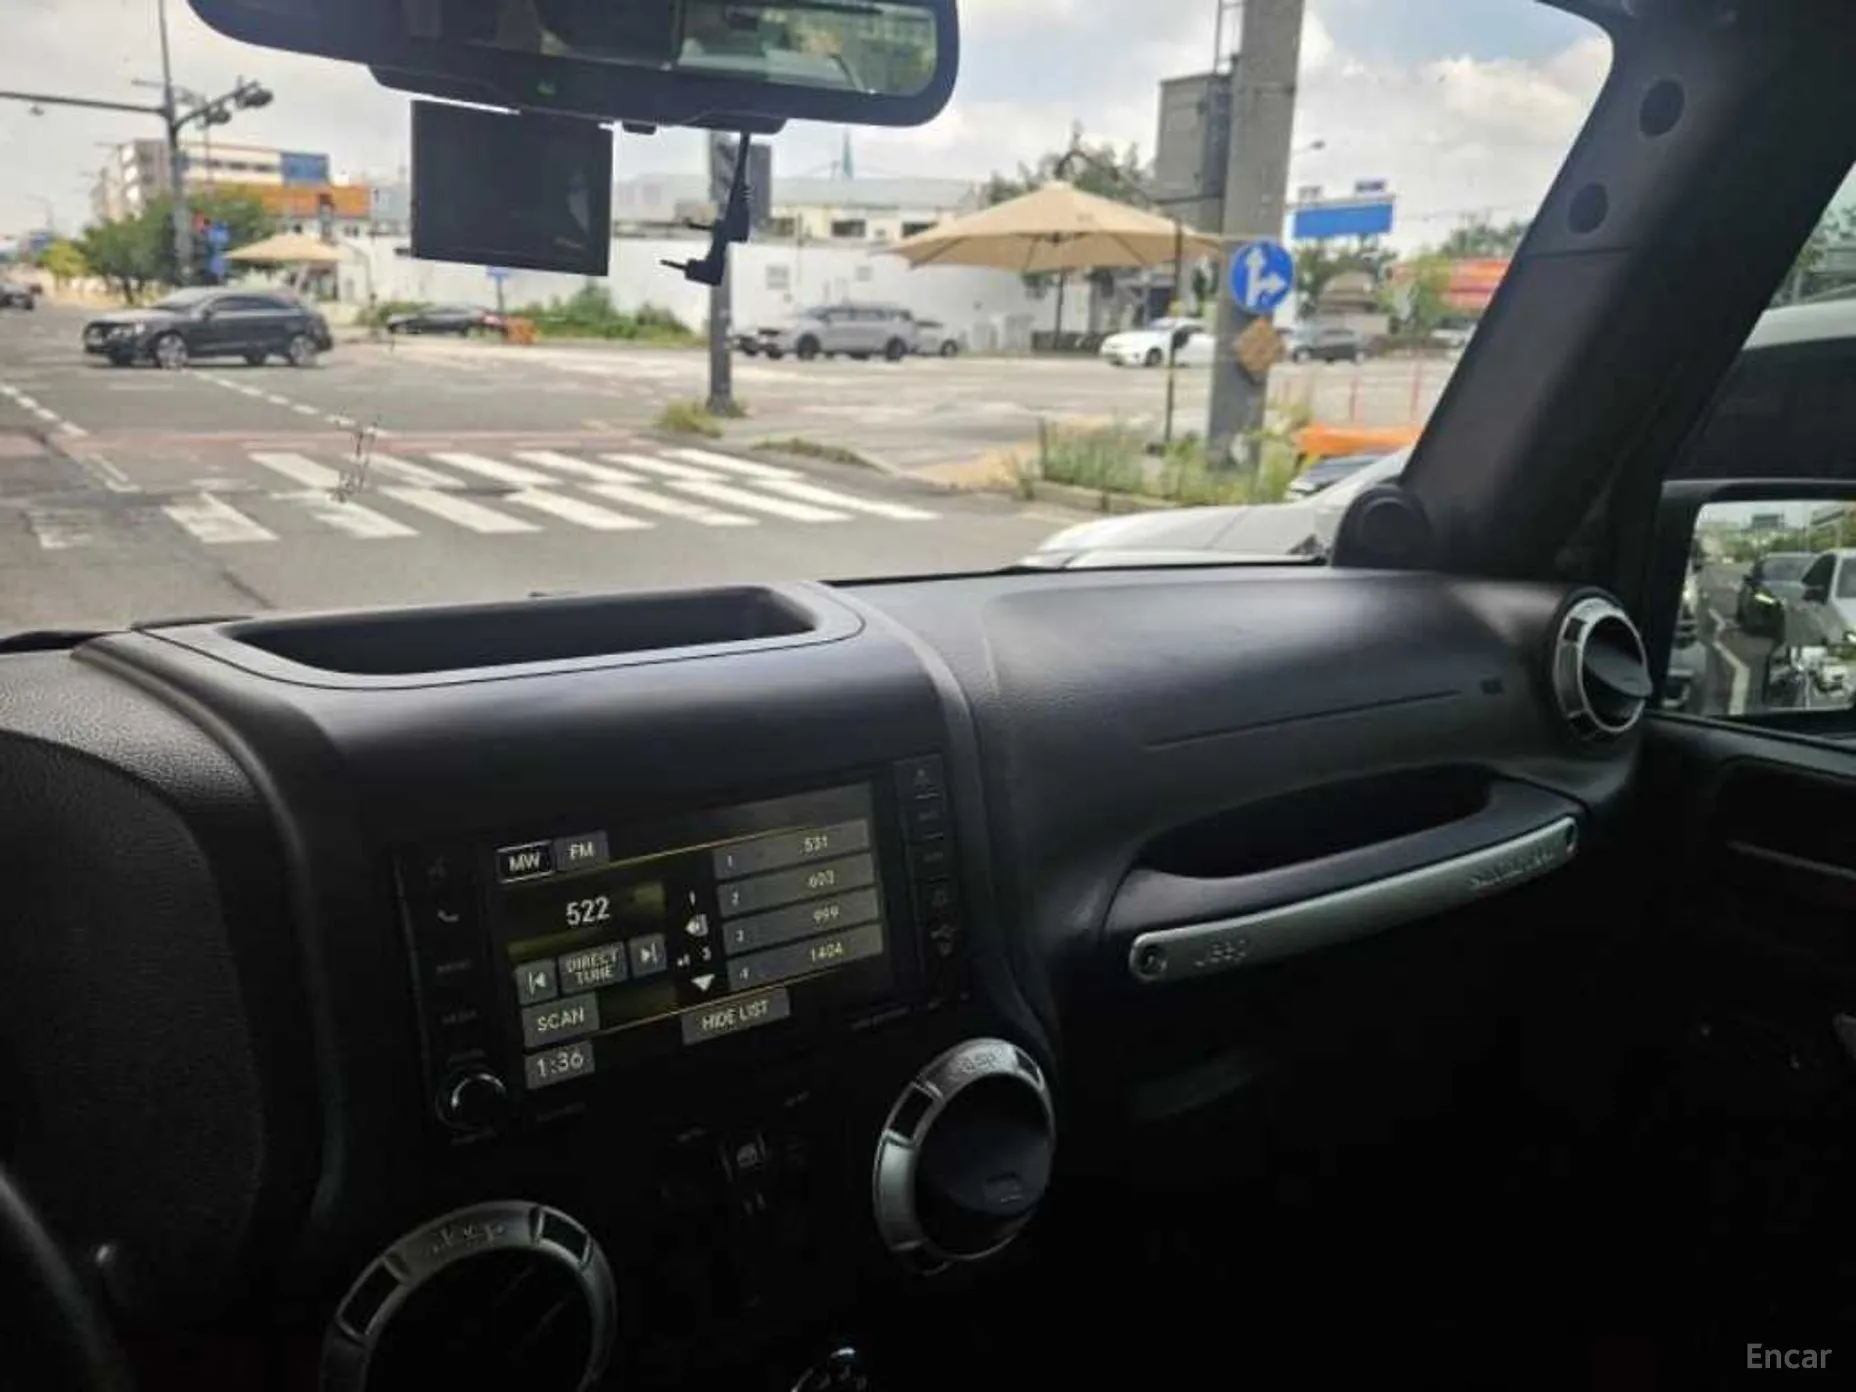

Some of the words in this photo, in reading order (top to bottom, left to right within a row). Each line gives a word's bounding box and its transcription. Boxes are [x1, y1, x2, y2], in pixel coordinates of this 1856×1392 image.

[509, 852, 541, 872] MW
[569, 841, 594, 860] FM
[565, 895, 611, 926] 522
[566, 948, 618, 973] DIRECT
[537, 1006, 585, 1032] SCAN
[701, 1009, 735, 1030] HIDE
[738, 1000, 769, 1021] LIST
